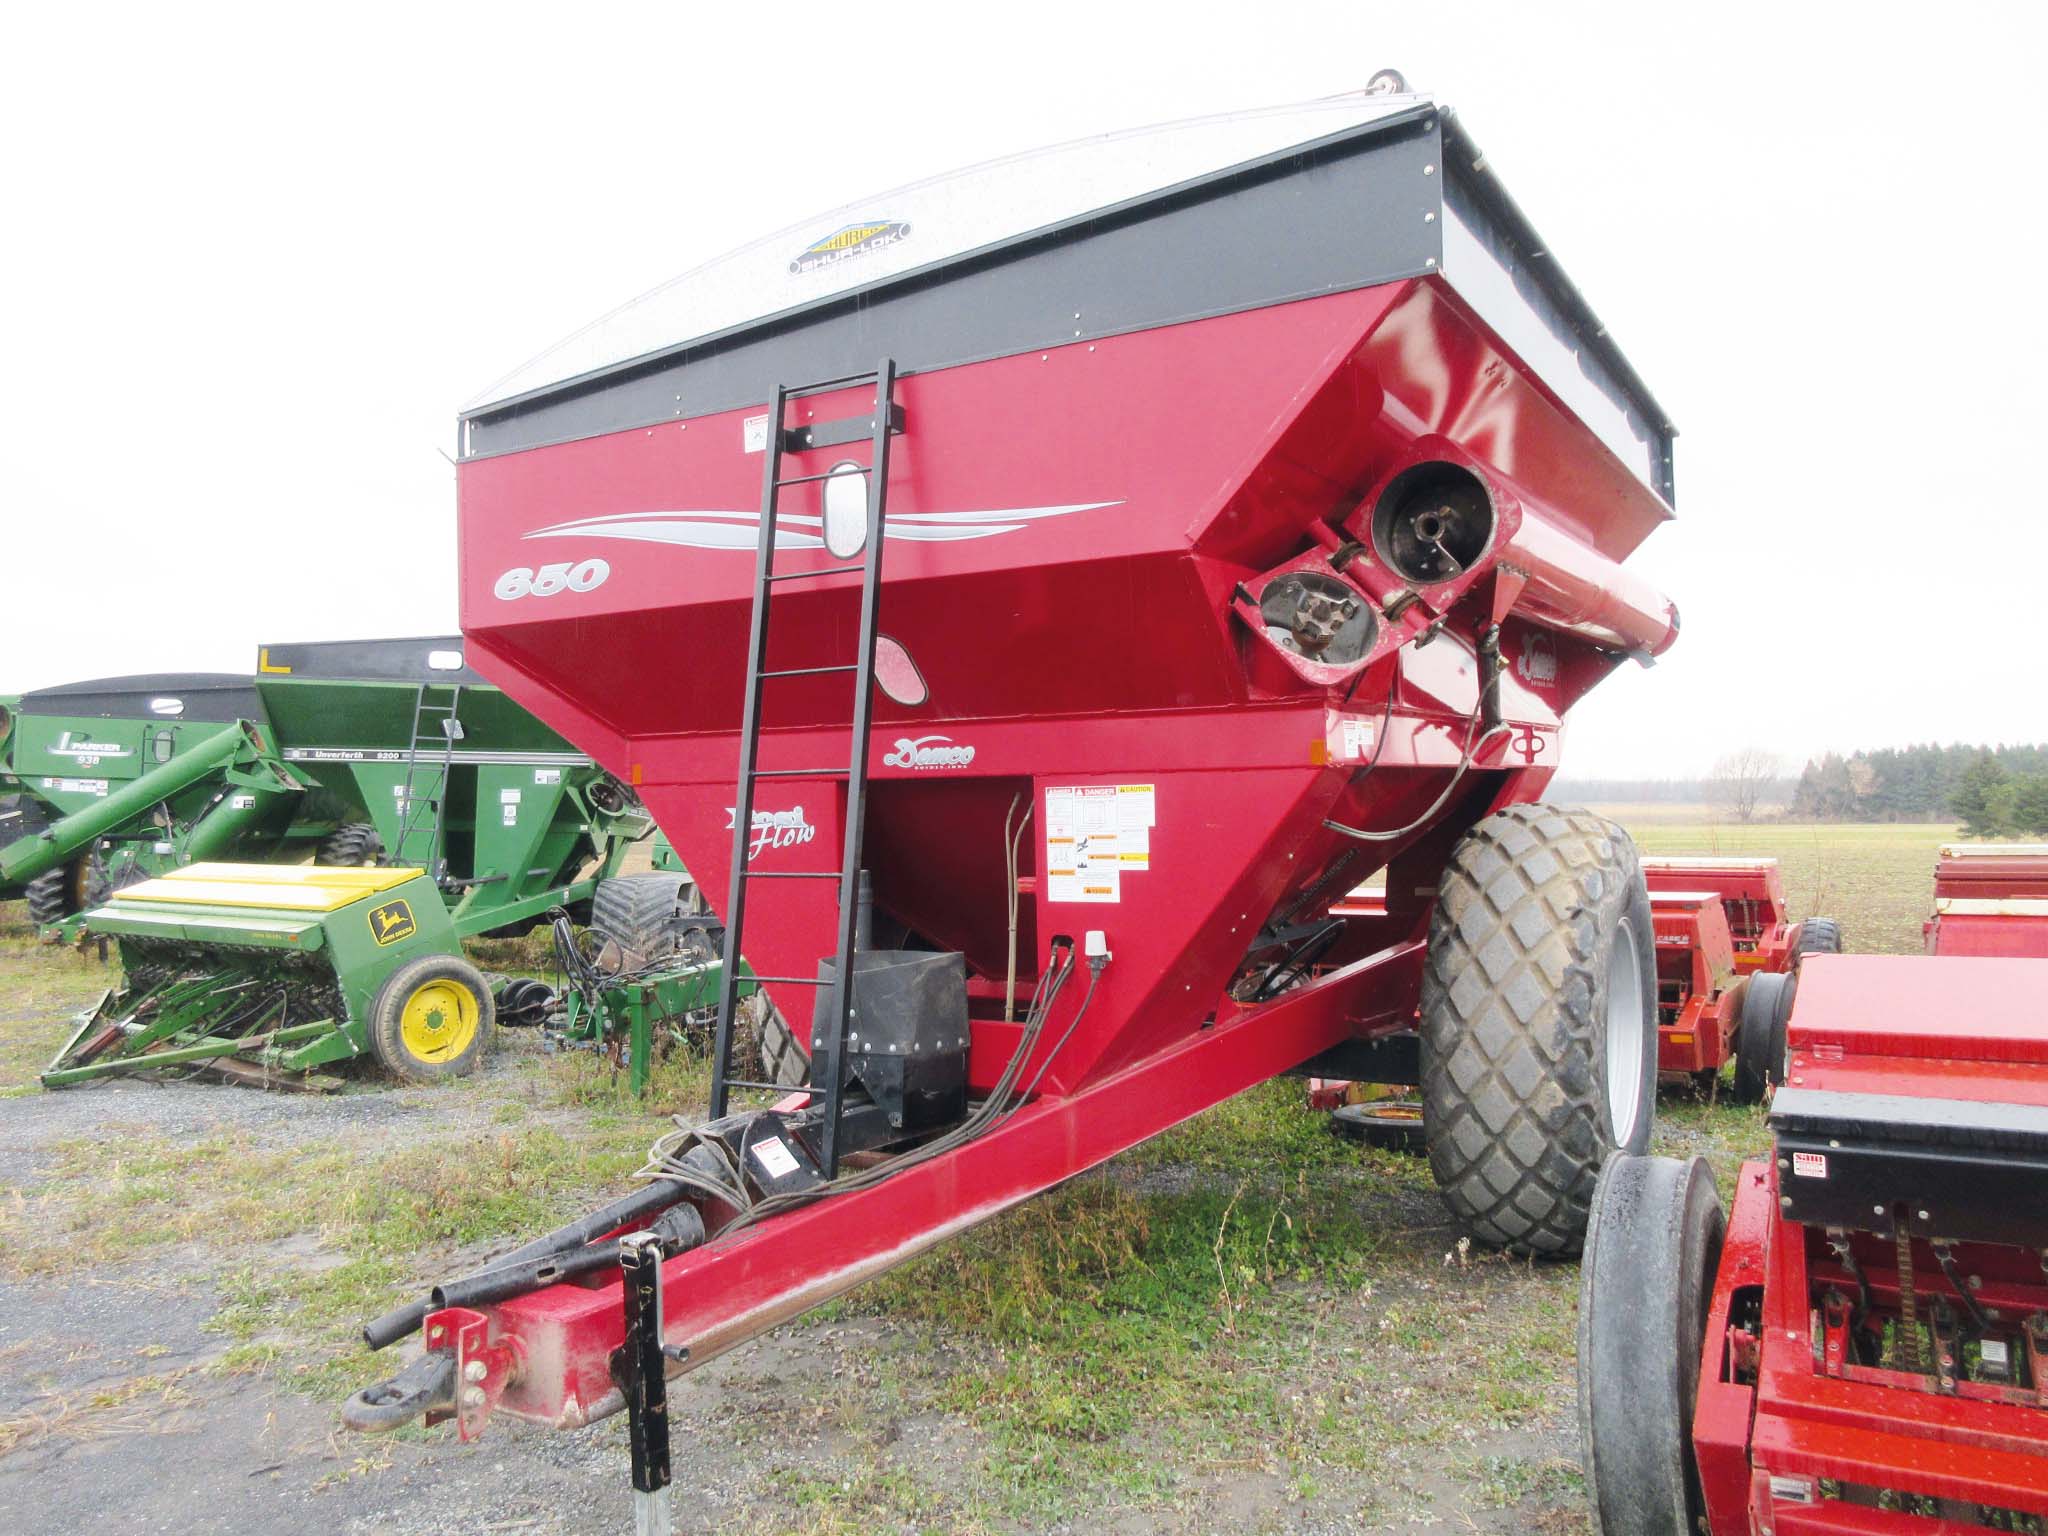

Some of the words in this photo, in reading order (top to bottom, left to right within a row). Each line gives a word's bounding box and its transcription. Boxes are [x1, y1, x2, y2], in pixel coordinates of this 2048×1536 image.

[494, 558, 610, 600] 650
[314, 751, 364, 760] Unverferth
[376, 752, 400, 760] 9200
[883, 735, 975, 768] Demco
[1084, 787, 1115, 796] DANGER
[1125, 785, 1152, 793] CAUTION
[747, 820, 816, 861] Flow
